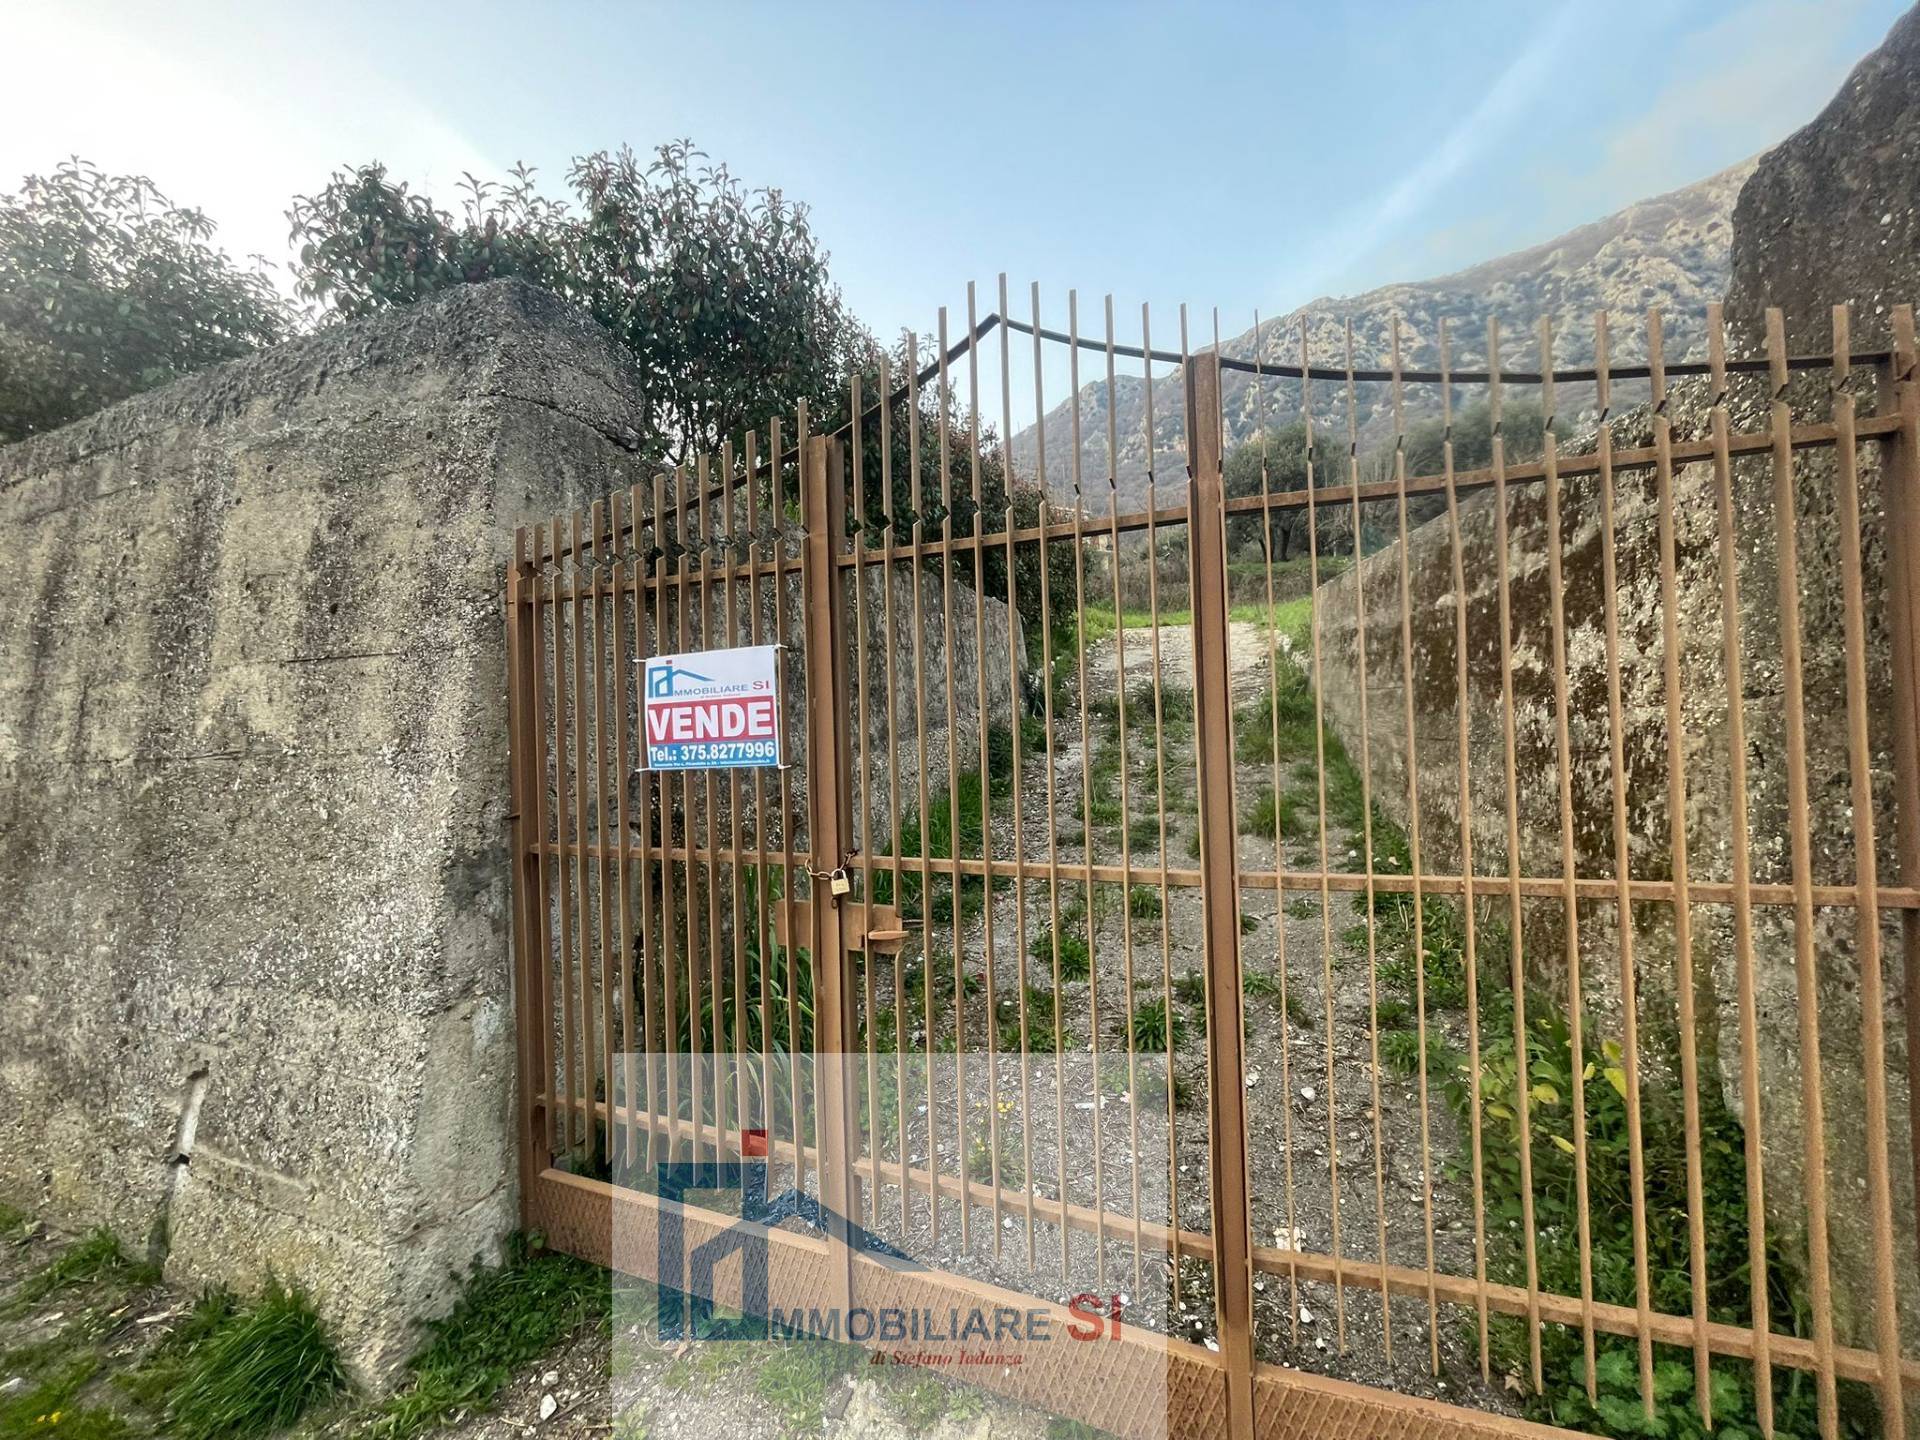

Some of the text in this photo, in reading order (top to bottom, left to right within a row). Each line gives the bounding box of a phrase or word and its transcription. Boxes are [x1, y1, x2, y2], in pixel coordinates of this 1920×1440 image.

[752, 680, 770, 690] SI
[648, 701, 773, 741] VENDE
[651, 741, 775, 762] Tel.: 375.8277996
